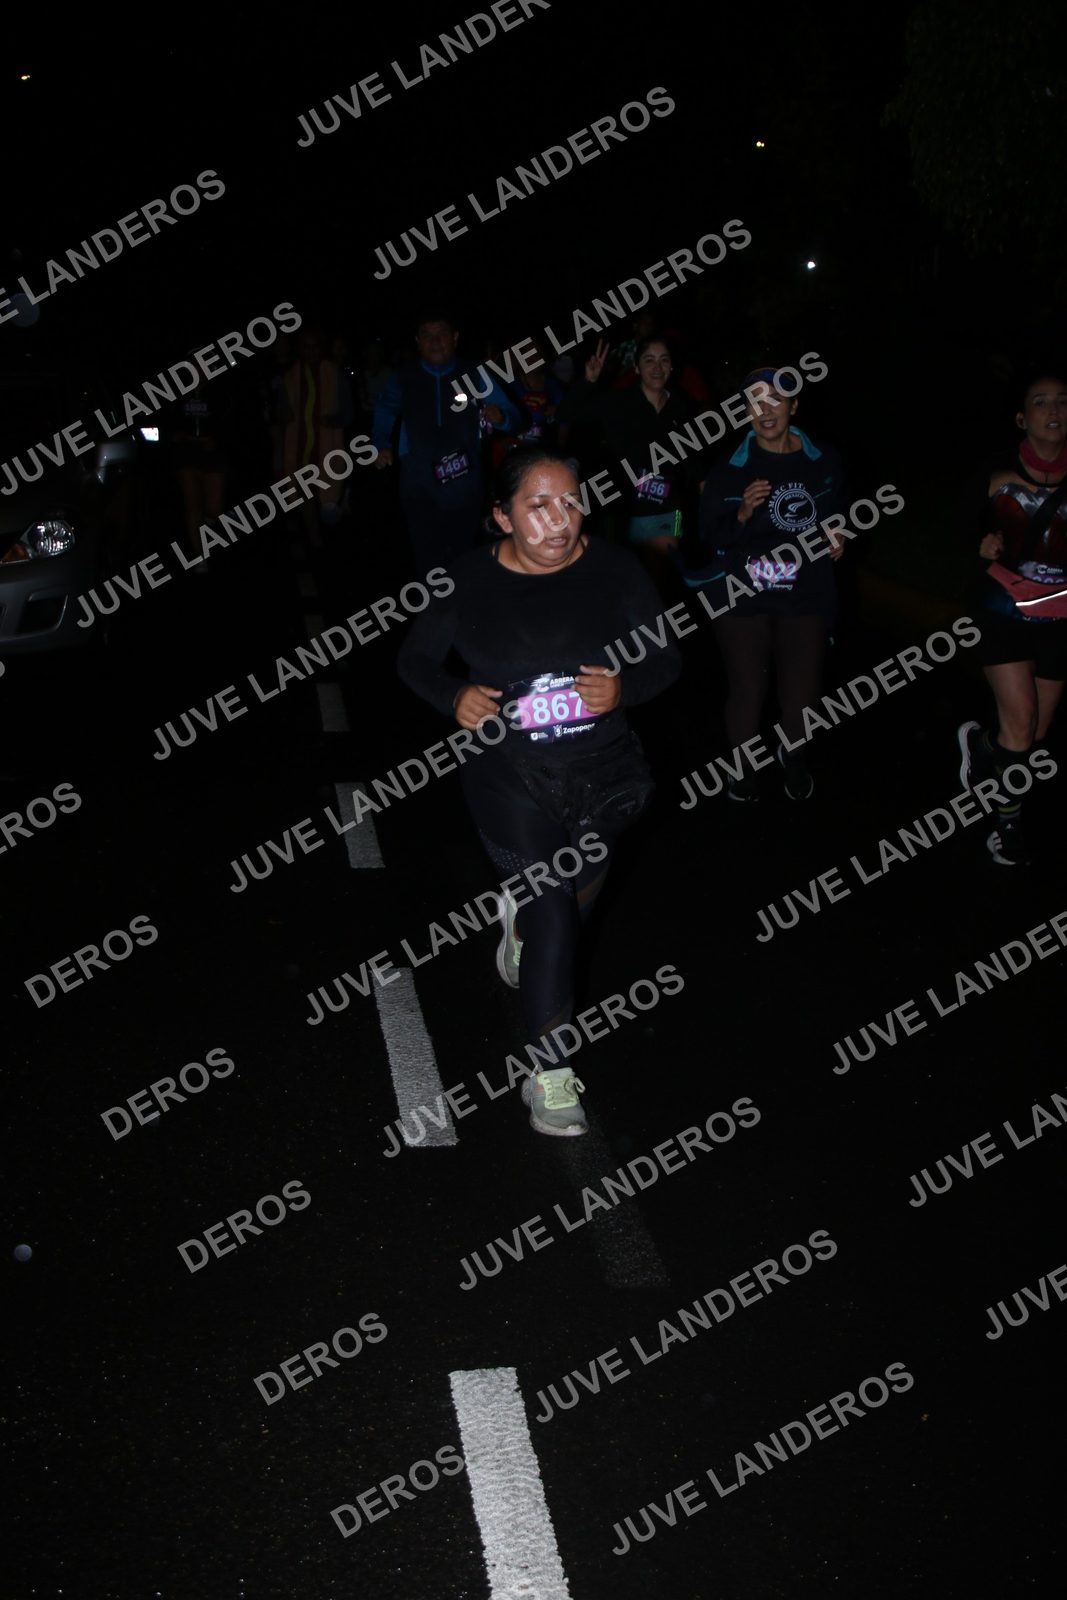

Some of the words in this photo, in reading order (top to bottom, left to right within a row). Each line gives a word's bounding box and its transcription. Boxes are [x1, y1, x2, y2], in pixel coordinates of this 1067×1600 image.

[437, 453, 468, 478] 1461
[752, 560, 797, 580] 1022
[531, 690, 583, 724] 867
